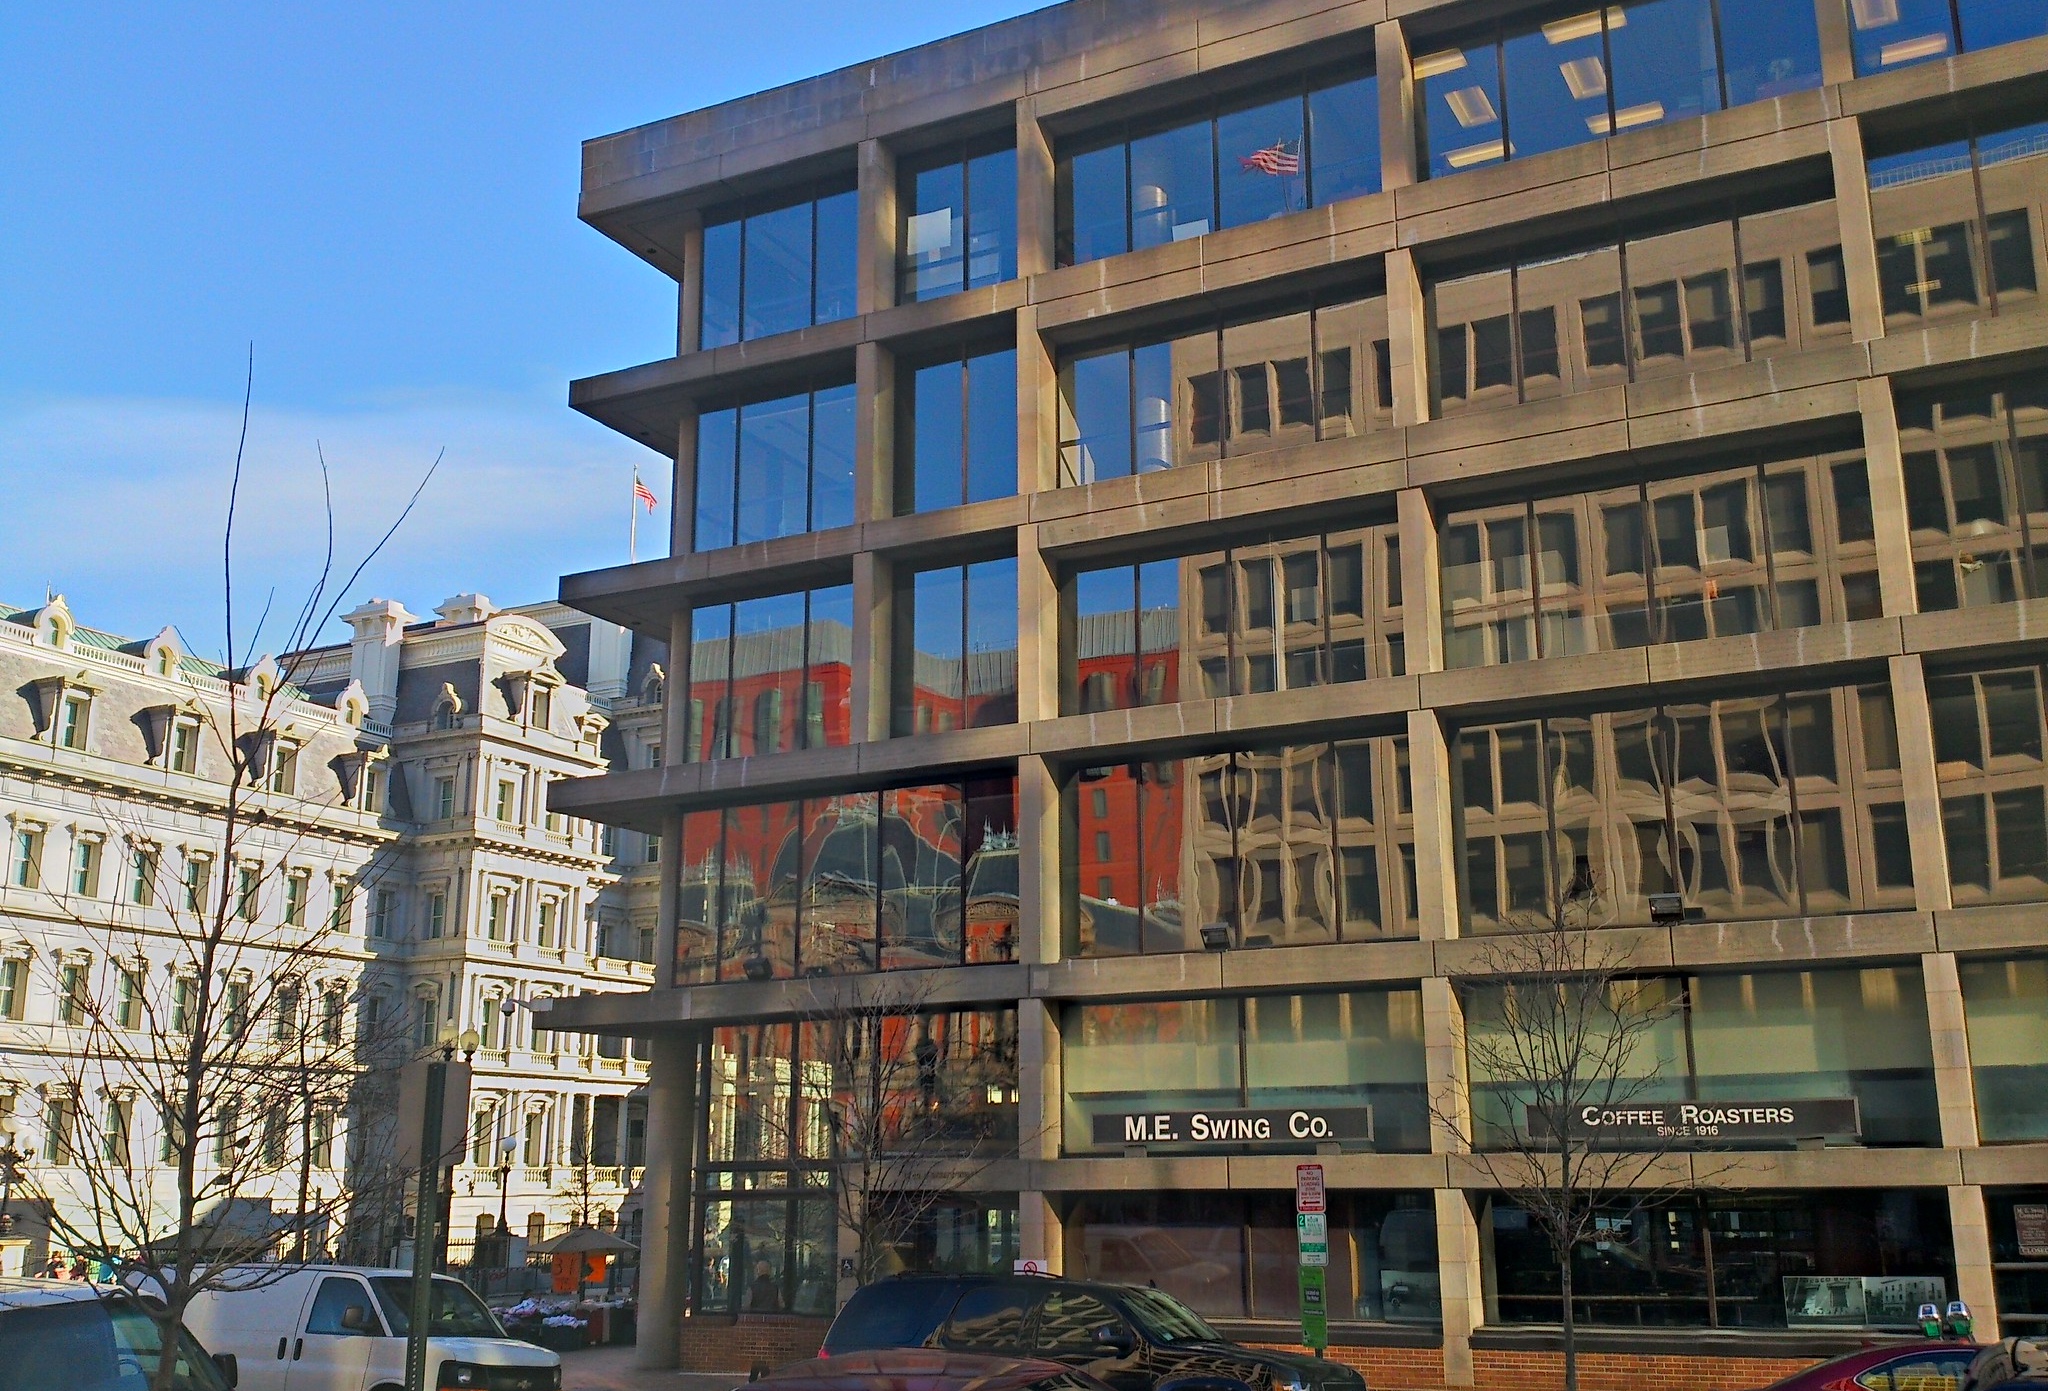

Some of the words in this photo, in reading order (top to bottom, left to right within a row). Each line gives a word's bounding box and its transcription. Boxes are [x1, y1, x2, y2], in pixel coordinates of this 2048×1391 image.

[1581, 1105, 1664, 1126] COFFEE
[1681, 1104, 1795, 1125] ROASTERS
[1125, 1115, 1179, 1141] M.E.
[1657, 1125, 1691, 1136] SINCE
[1695, 1125, 1719, 1136] 1916
[1299, 1215, 1304, 1226] 2
